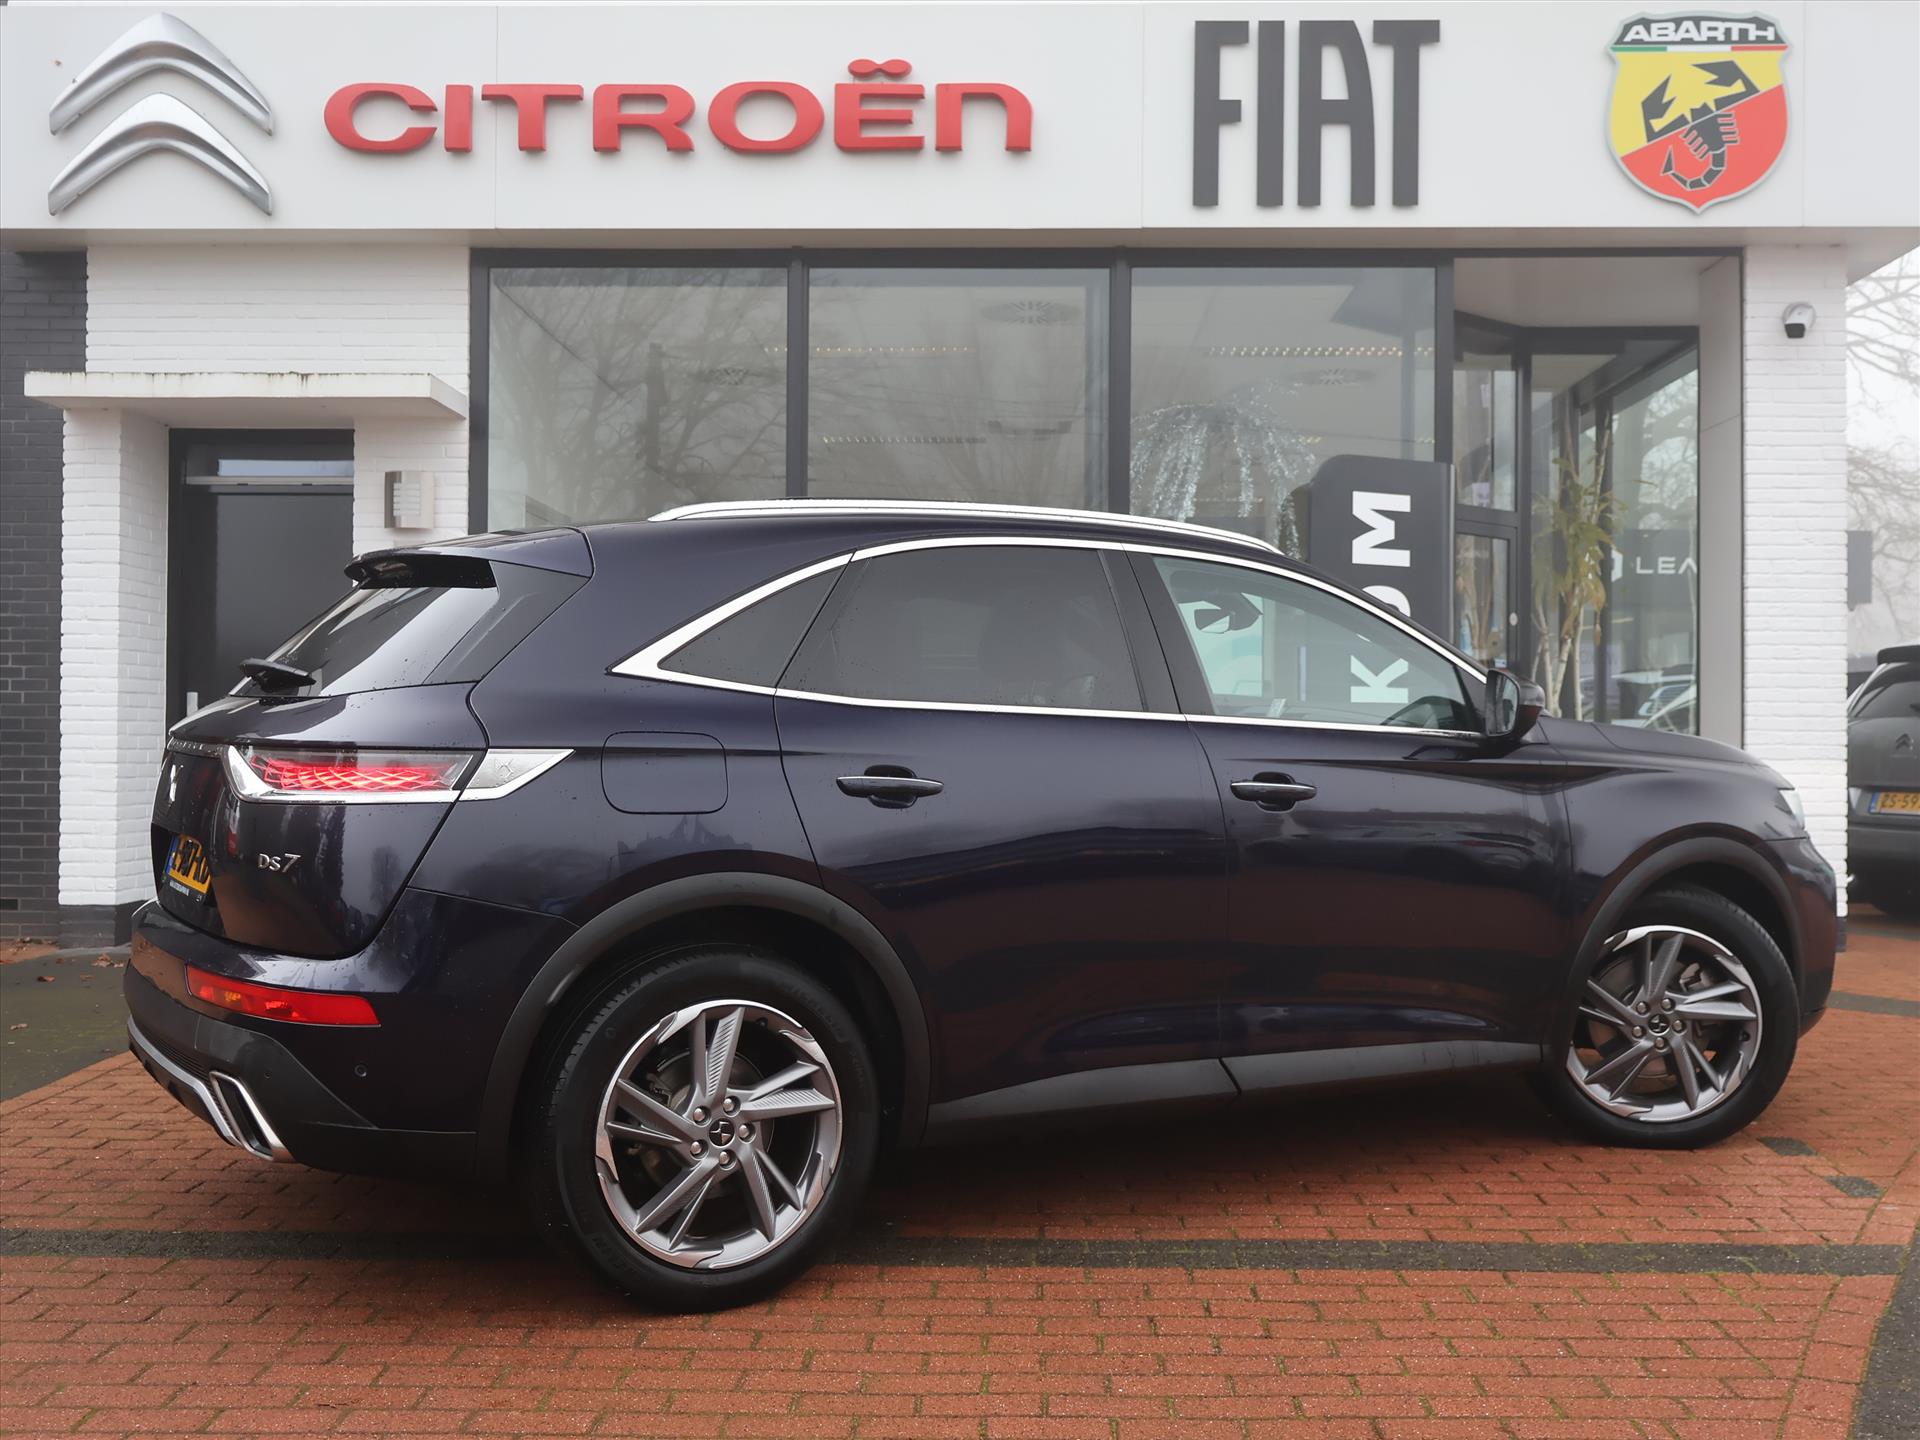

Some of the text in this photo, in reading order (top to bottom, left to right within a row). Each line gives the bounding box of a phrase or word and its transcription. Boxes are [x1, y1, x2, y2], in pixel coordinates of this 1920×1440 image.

[1623, 20, 1776, 42] ABARTH
[323, 58, 1034, 154] CITROËN
[1193, 20, 1440, 206] FIAT
